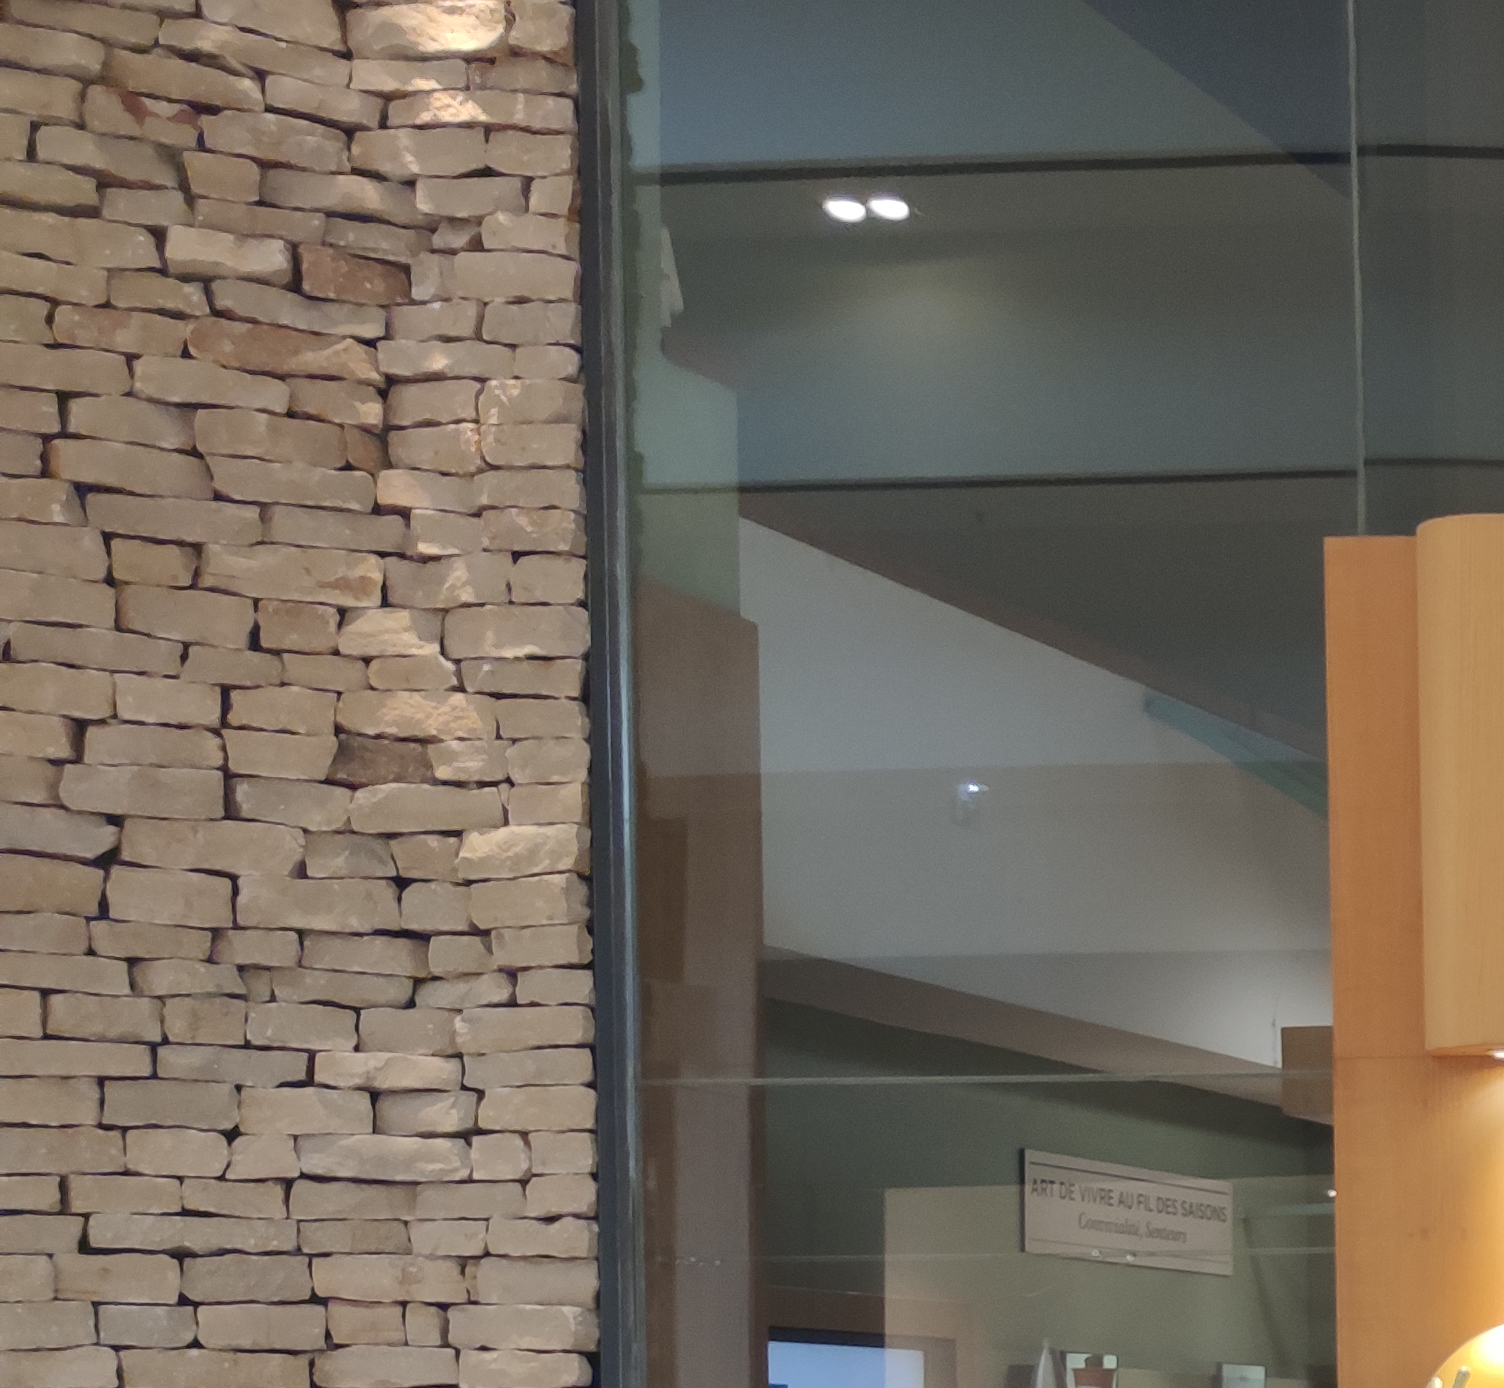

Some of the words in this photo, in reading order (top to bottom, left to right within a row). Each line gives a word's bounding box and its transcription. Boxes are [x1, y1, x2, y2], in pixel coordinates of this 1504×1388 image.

[1030, 1178, 1056, 1199] ART
[1059, 1182, 1075, 1202] DE
[1079, 1185, 1114, 1206] VIVRE
[1118, 1191, 1134, 1211] AU
[1136, 1193, 1153, 1212] FIL
[1156, 1196, 1178, 1216] DES
[1181, 1200, 1228, 1223] SAISONS
